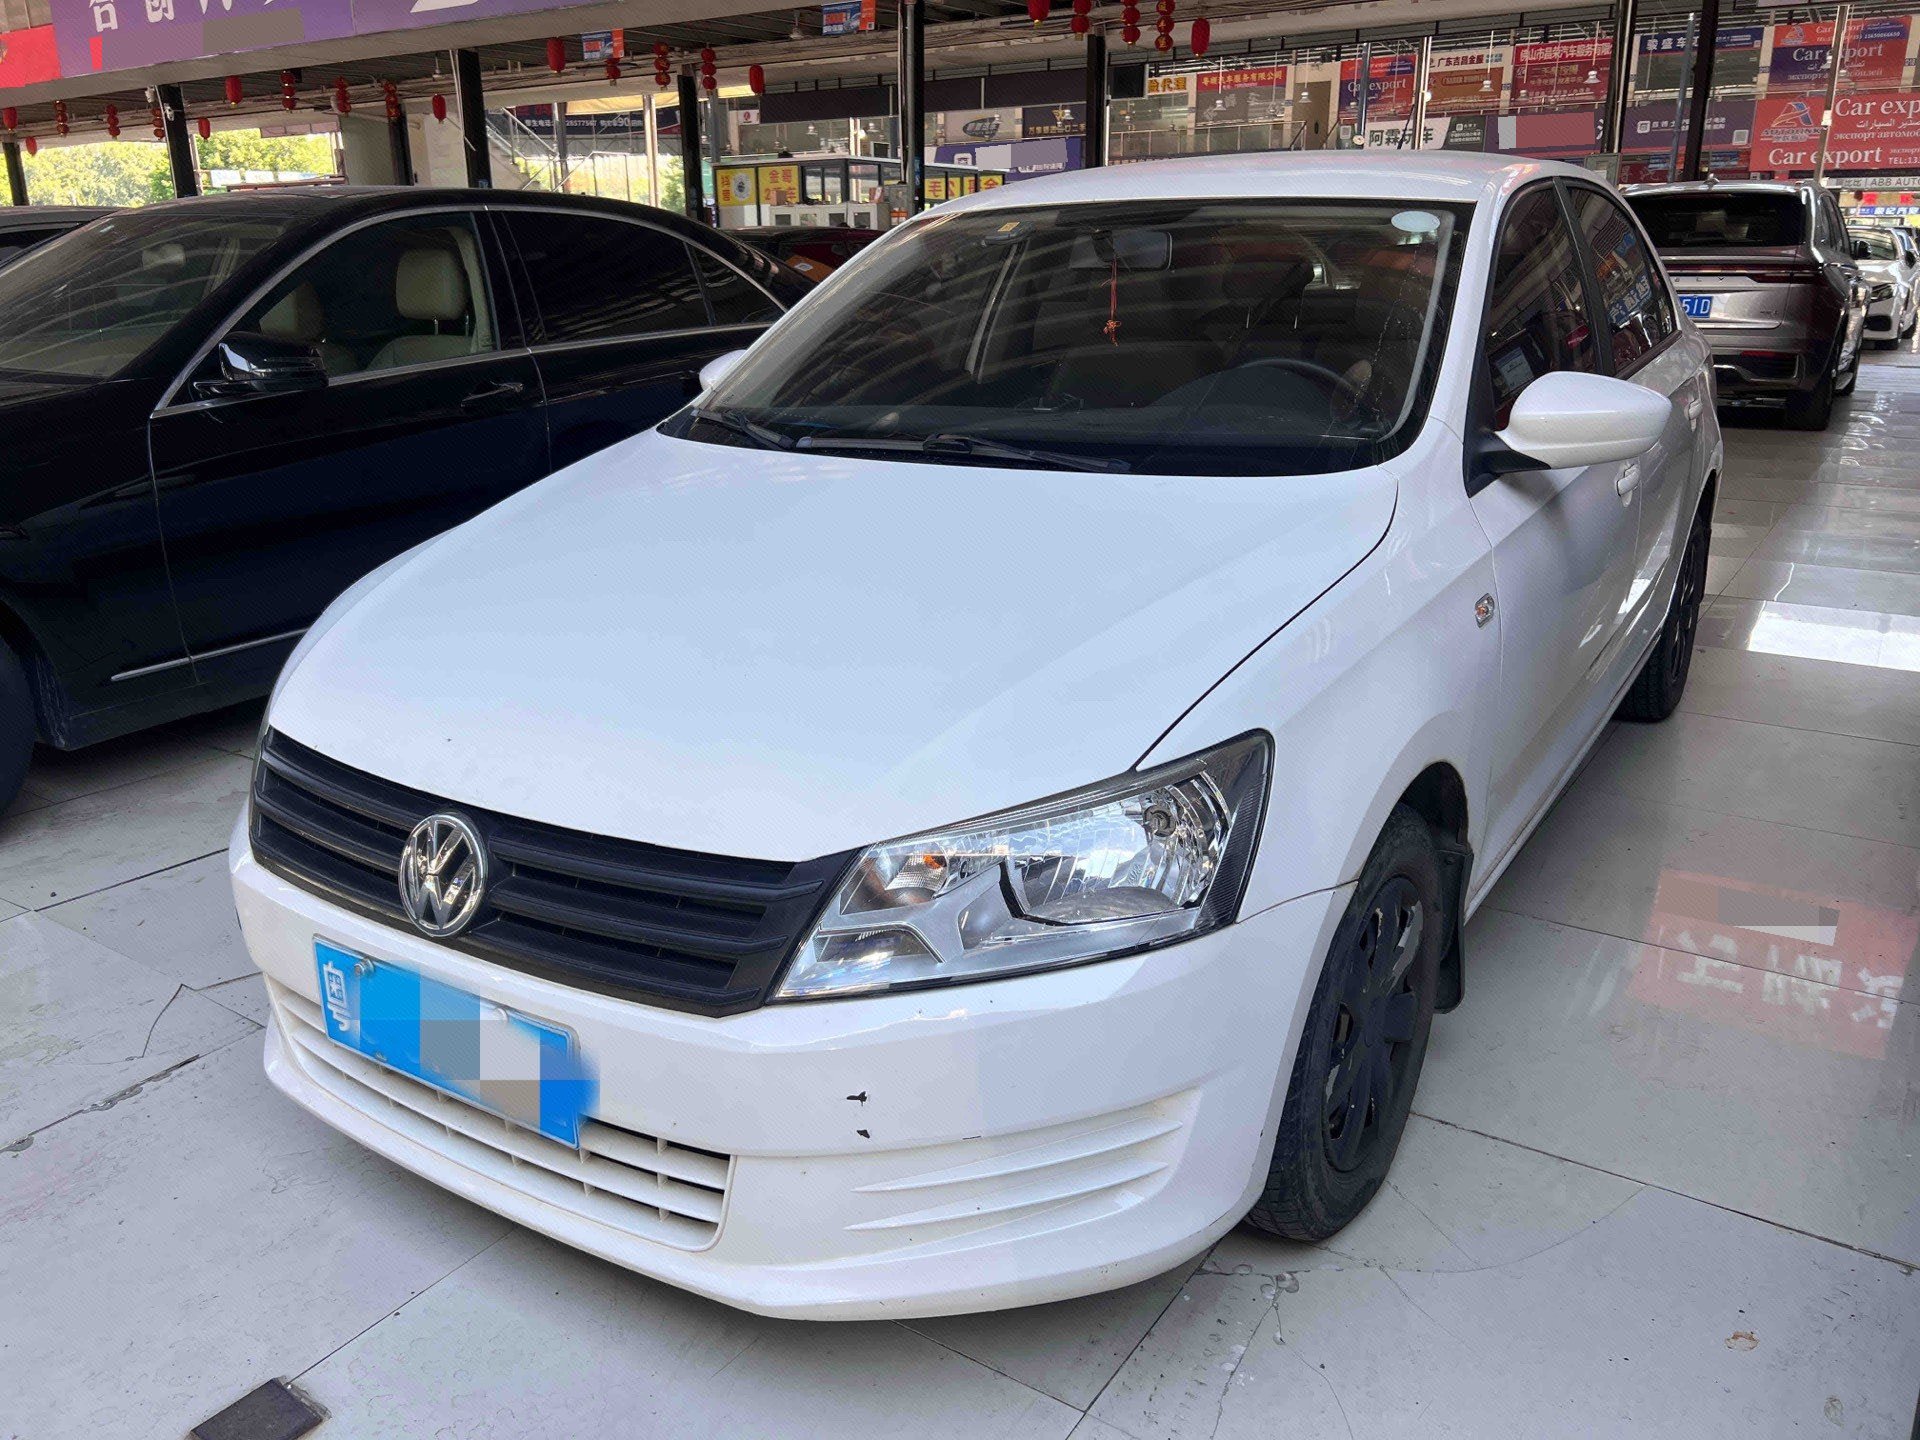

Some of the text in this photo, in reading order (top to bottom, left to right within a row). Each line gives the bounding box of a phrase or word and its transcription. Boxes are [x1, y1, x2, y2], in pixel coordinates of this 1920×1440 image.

[1793, 46, 1824, 62] Car
[1835, 98, 1876, 117] Car
[1769, 149, 1806, 165] Car
